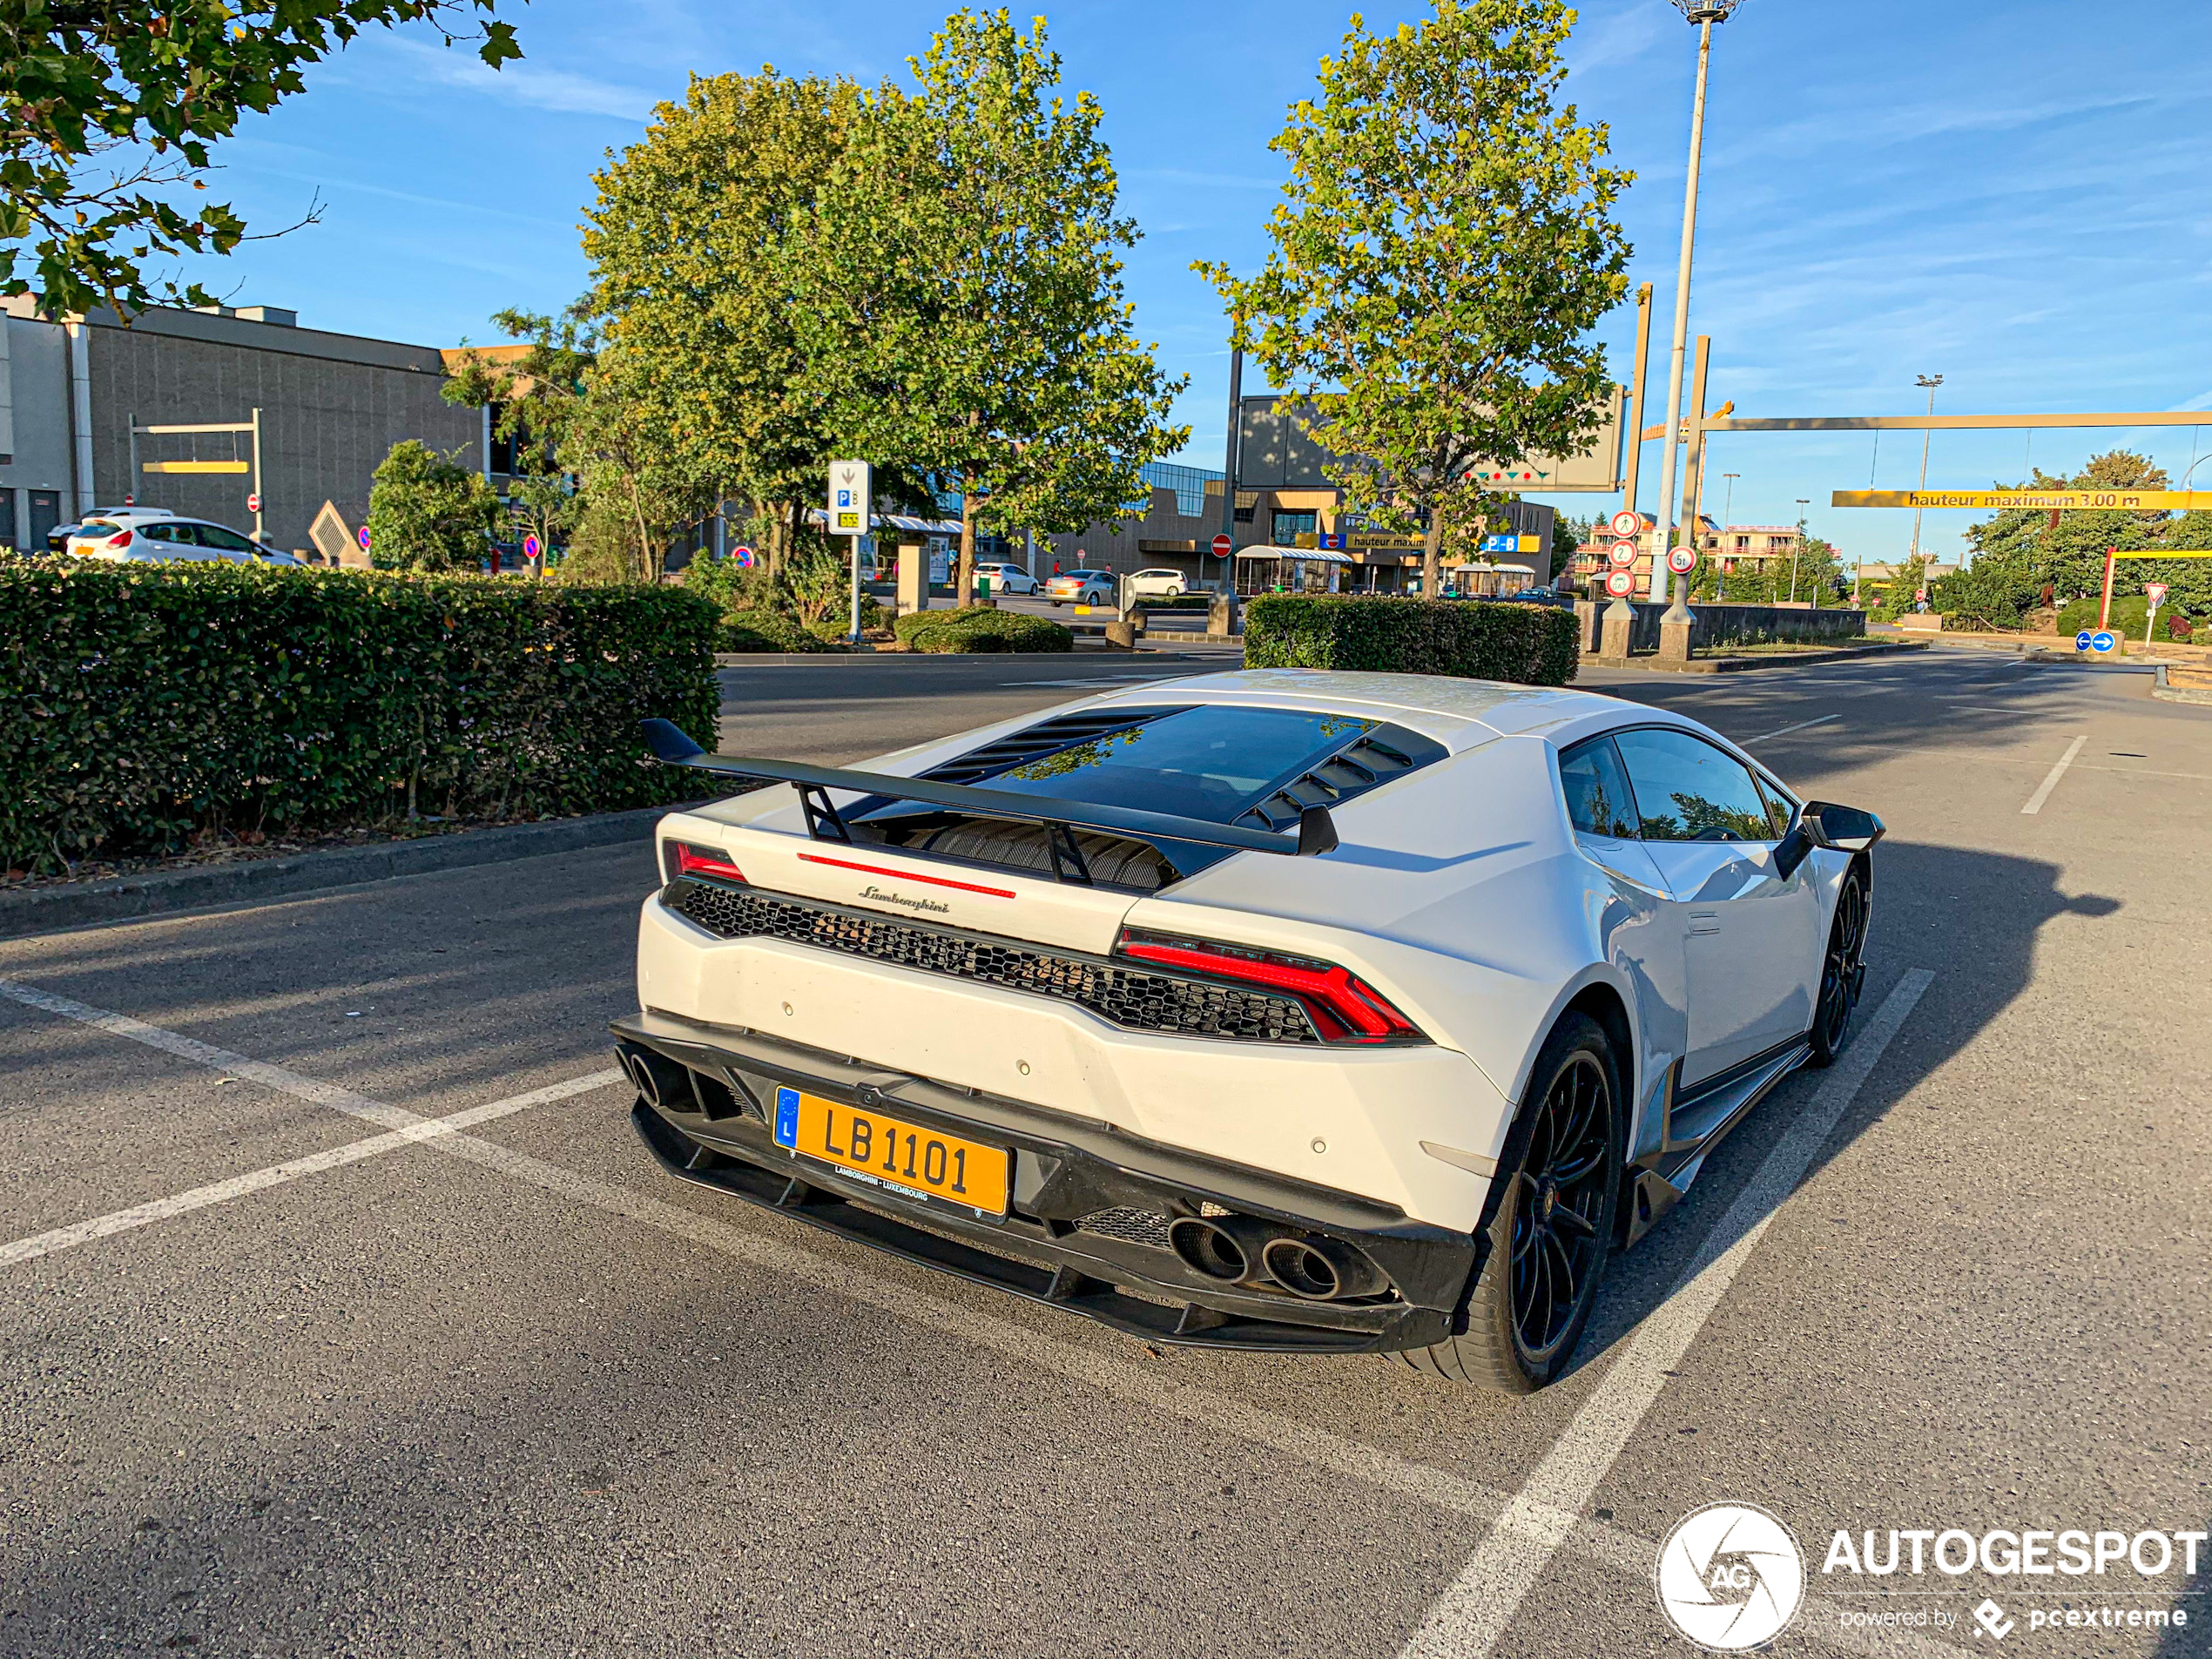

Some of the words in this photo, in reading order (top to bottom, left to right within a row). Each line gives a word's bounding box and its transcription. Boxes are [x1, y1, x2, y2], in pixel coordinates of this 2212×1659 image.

[840, 492, 848, 505] P
[1908, 493, 1977, 506] hauteur
[1984, 493, 2075, 506] maximum
[2080, 494, 2117, 507] 3.00
[2121, 496, 2140, 507] m
[1354, 536, 1390, 546] hauteur
[1393, 536, 1427, 547] maxim
[858, 886, 949, 913] Lamborghini
[783, 1121, 791, 1137] L
[834, 1165, 879, 1186] LAMBORGHINI
[882, 1180, 928, 1201] LUXEMBOURG
